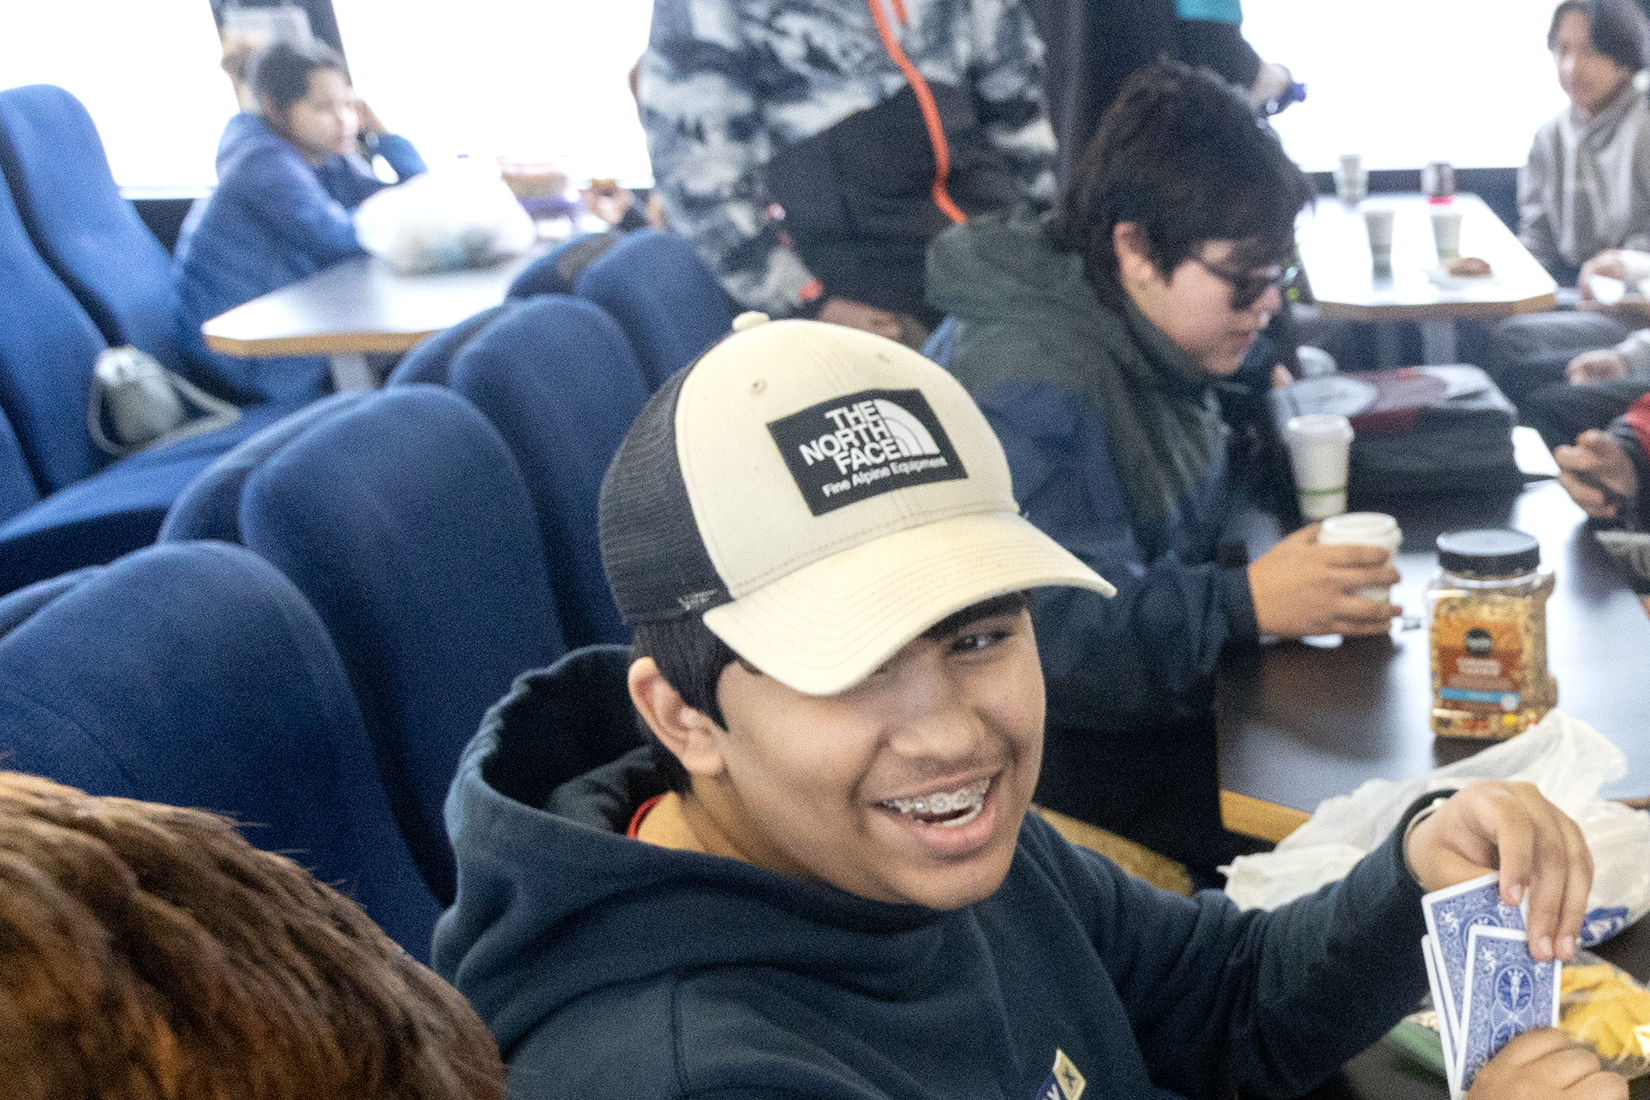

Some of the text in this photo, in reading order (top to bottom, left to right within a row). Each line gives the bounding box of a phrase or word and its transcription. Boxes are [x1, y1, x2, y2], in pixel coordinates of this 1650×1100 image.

[824, 400, 878, 429] THE
[799, 419, 893, 466] NORTH
[834, 438, 901, 475] FACE
[822, 457, 948, 497] Fine Alpine Equipment
